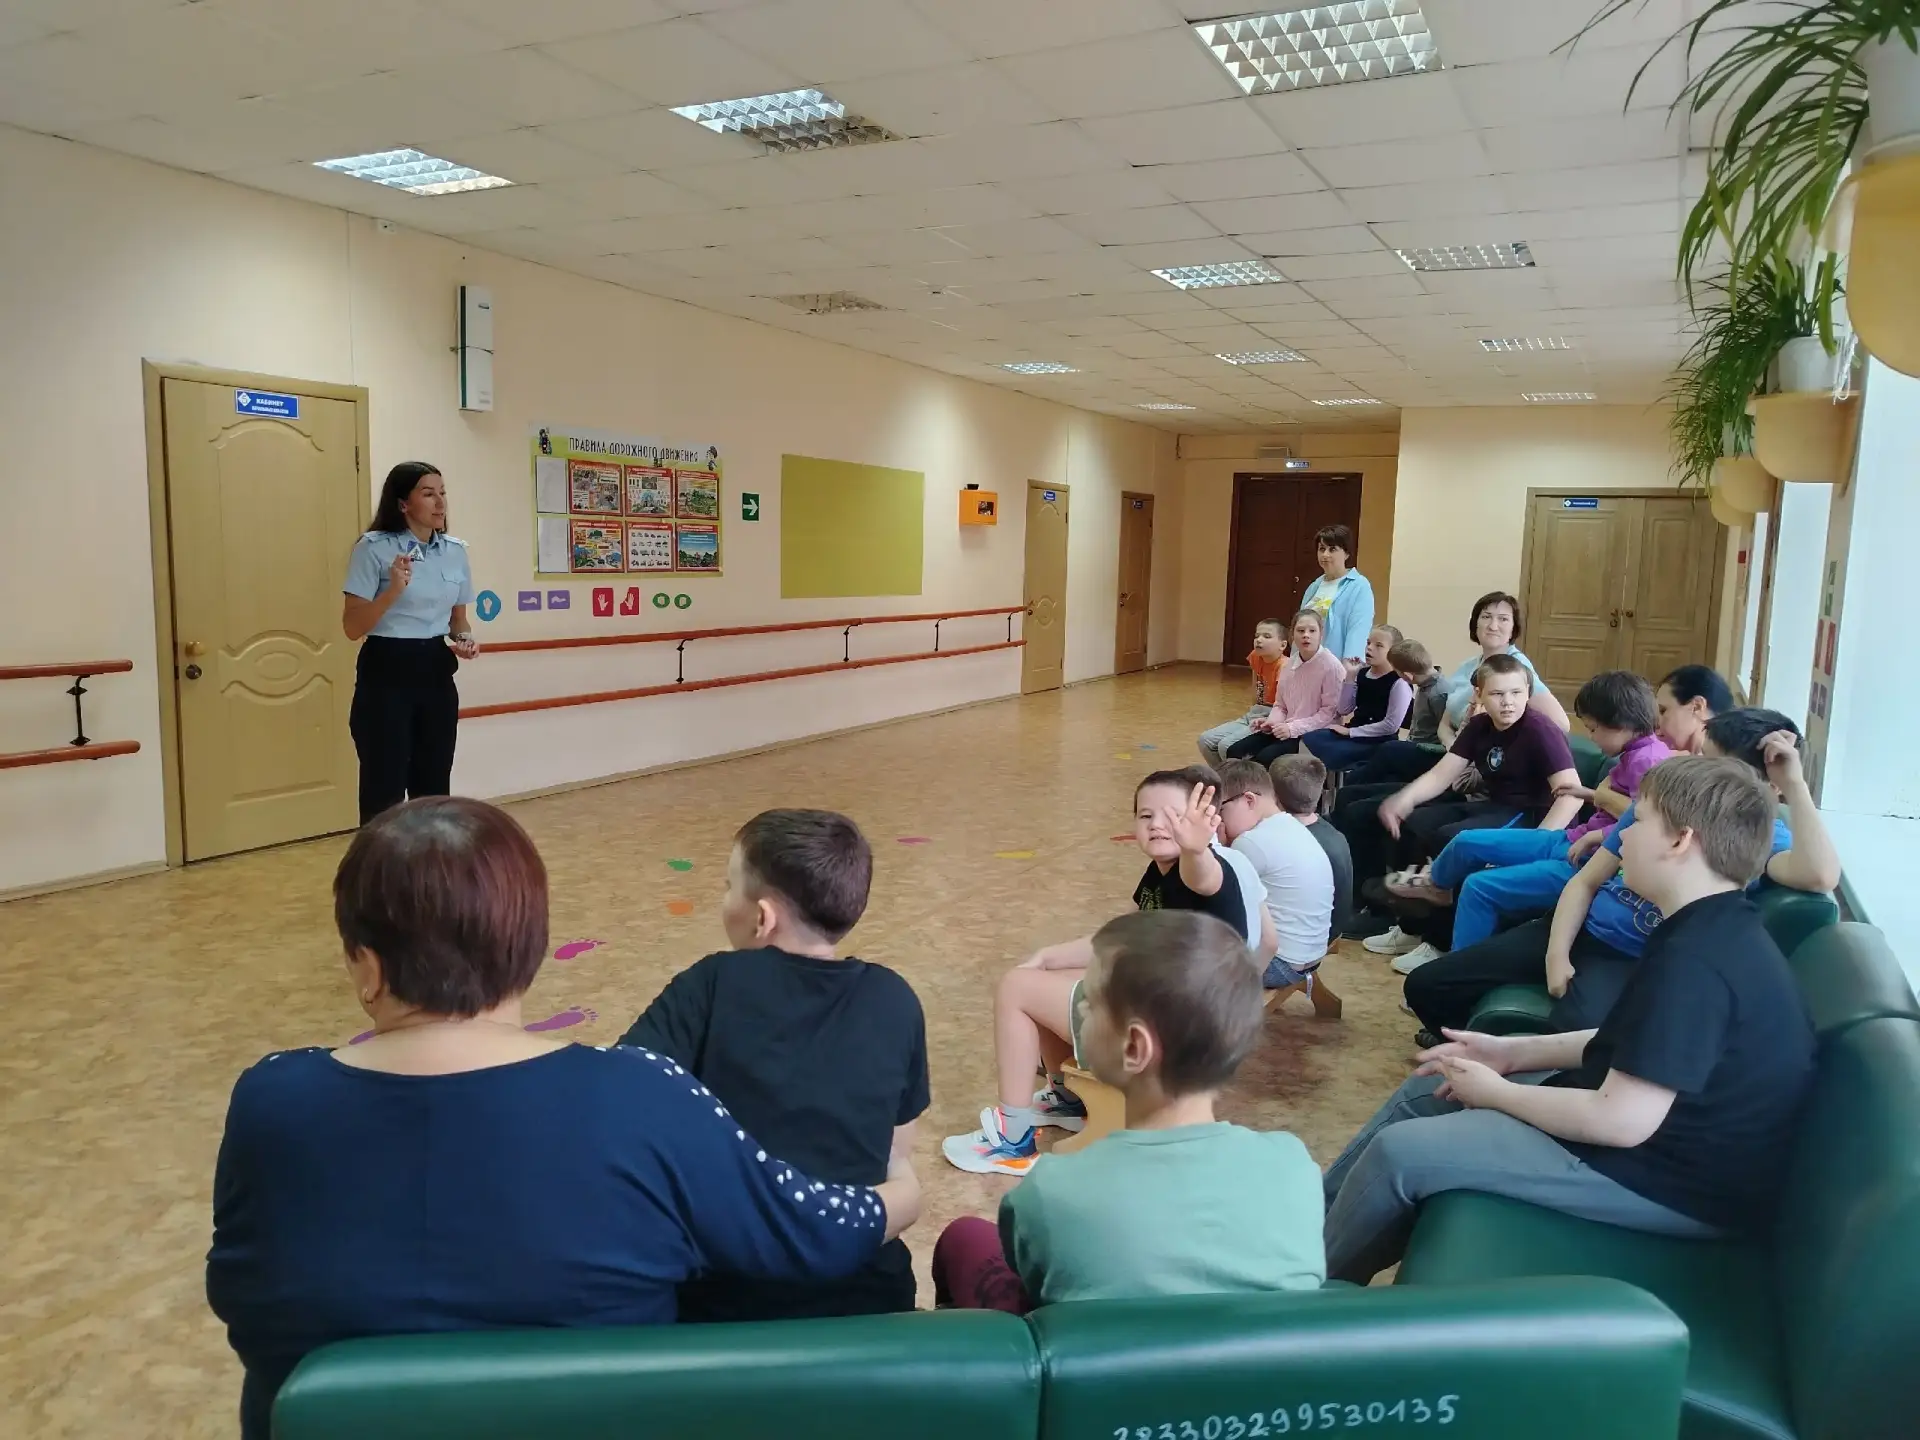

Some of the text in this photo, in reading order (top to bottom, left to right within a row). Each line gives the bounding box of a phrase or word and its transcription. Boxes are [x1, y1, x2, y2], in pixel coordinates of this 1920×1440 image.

[569, 437, 698, 463] ПРАВИЛА ДОРОЖНОГО ДВИЖЕНИЯ
